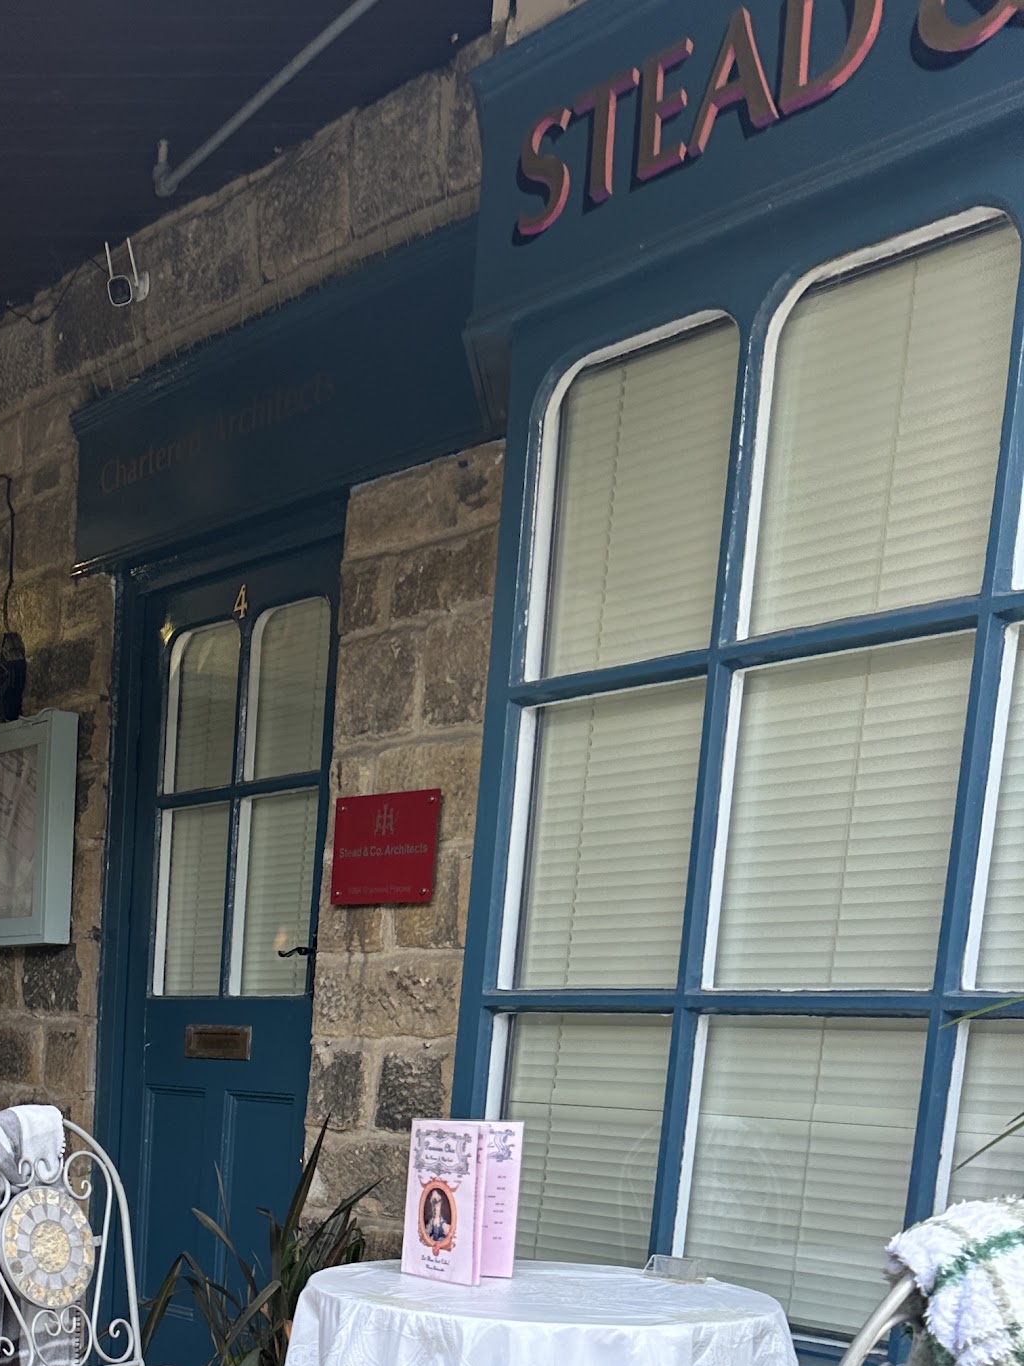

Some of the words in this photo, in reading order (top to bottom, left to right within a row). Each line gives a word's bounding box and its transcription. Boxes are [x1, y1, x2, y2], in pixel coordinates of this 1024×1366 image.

[516, 0, 884, 237] STEAD
[99, 424, 203, 494] Chartered
[211, 371, 337, 441] Architects
[233, 584, 248, 620] 4
[339, 846, 362, 859] Stead
[363, 847, 369, 857] &
[369, 845, 384, 857] Co.
[384, 842, 429, 857] Architects
